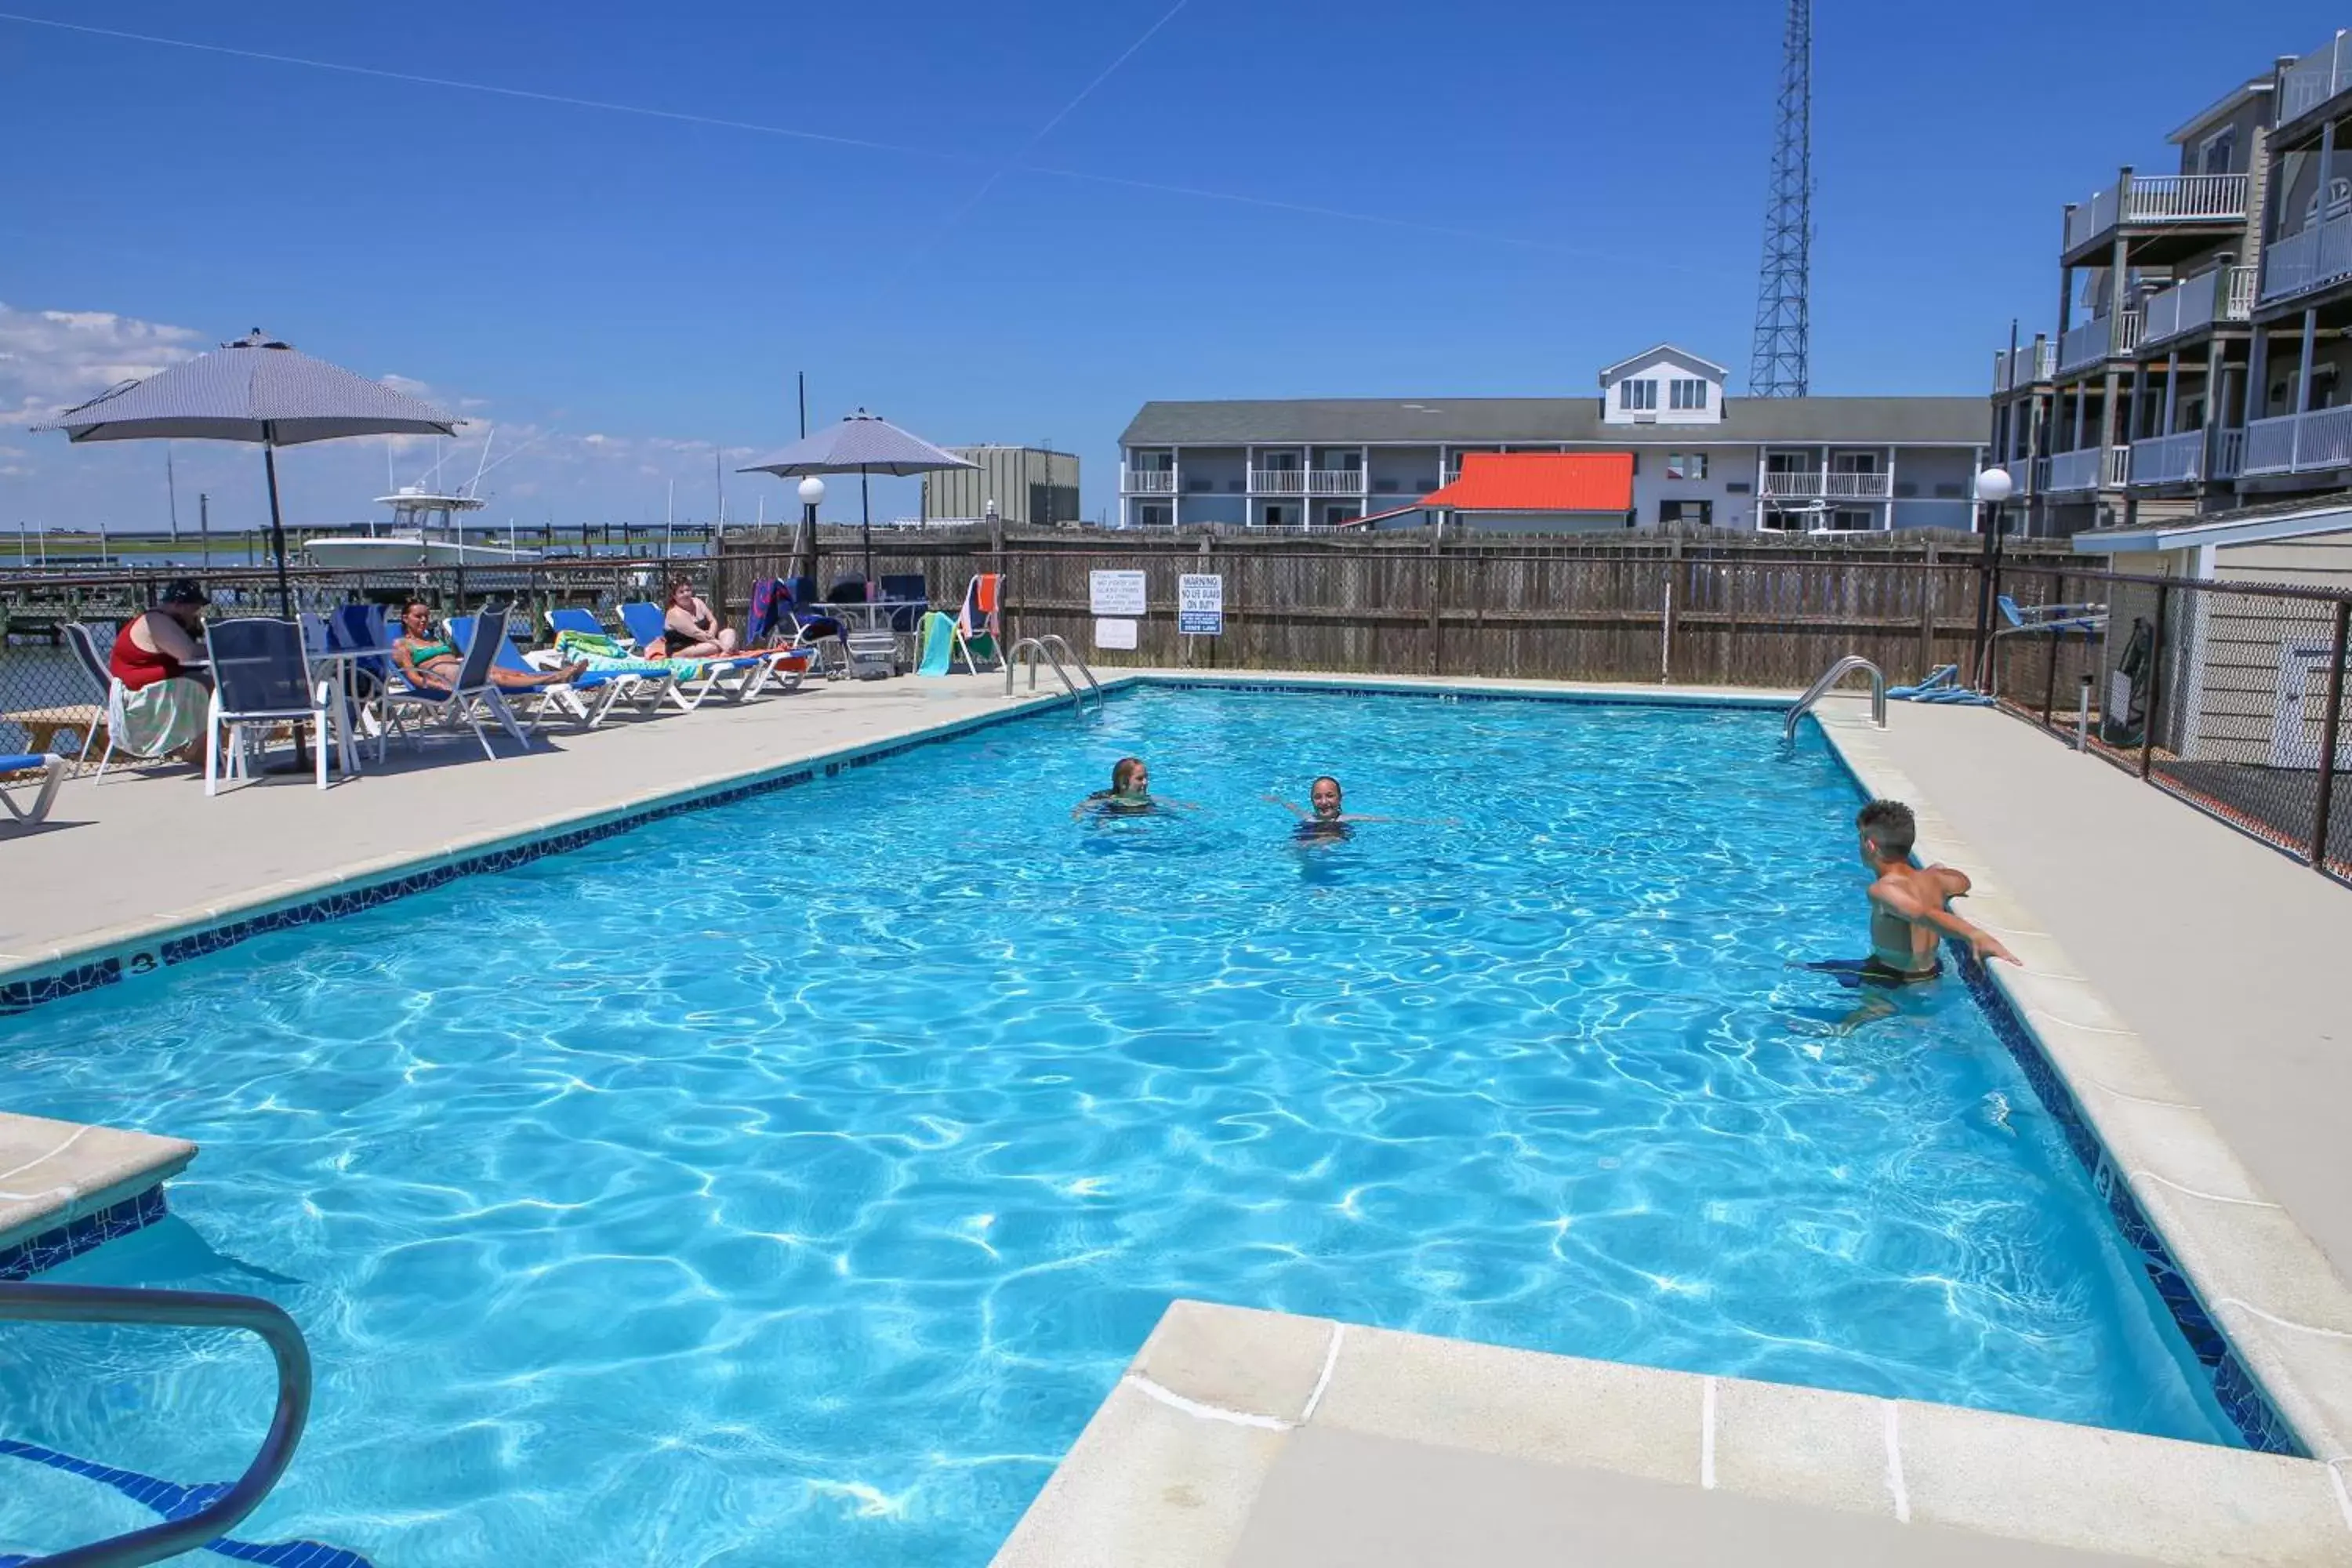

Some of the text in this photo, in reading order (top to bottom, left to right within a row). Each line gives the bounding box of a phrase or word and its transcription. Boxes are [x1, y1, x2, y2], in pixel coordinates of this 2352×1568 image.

[1183, 576, 1217, 586] WARNING
[1182, 589, 1191, 599] NO
[1187, 600, 1214, 609] ON DUTY
[131, 952, 158, 975] 3
